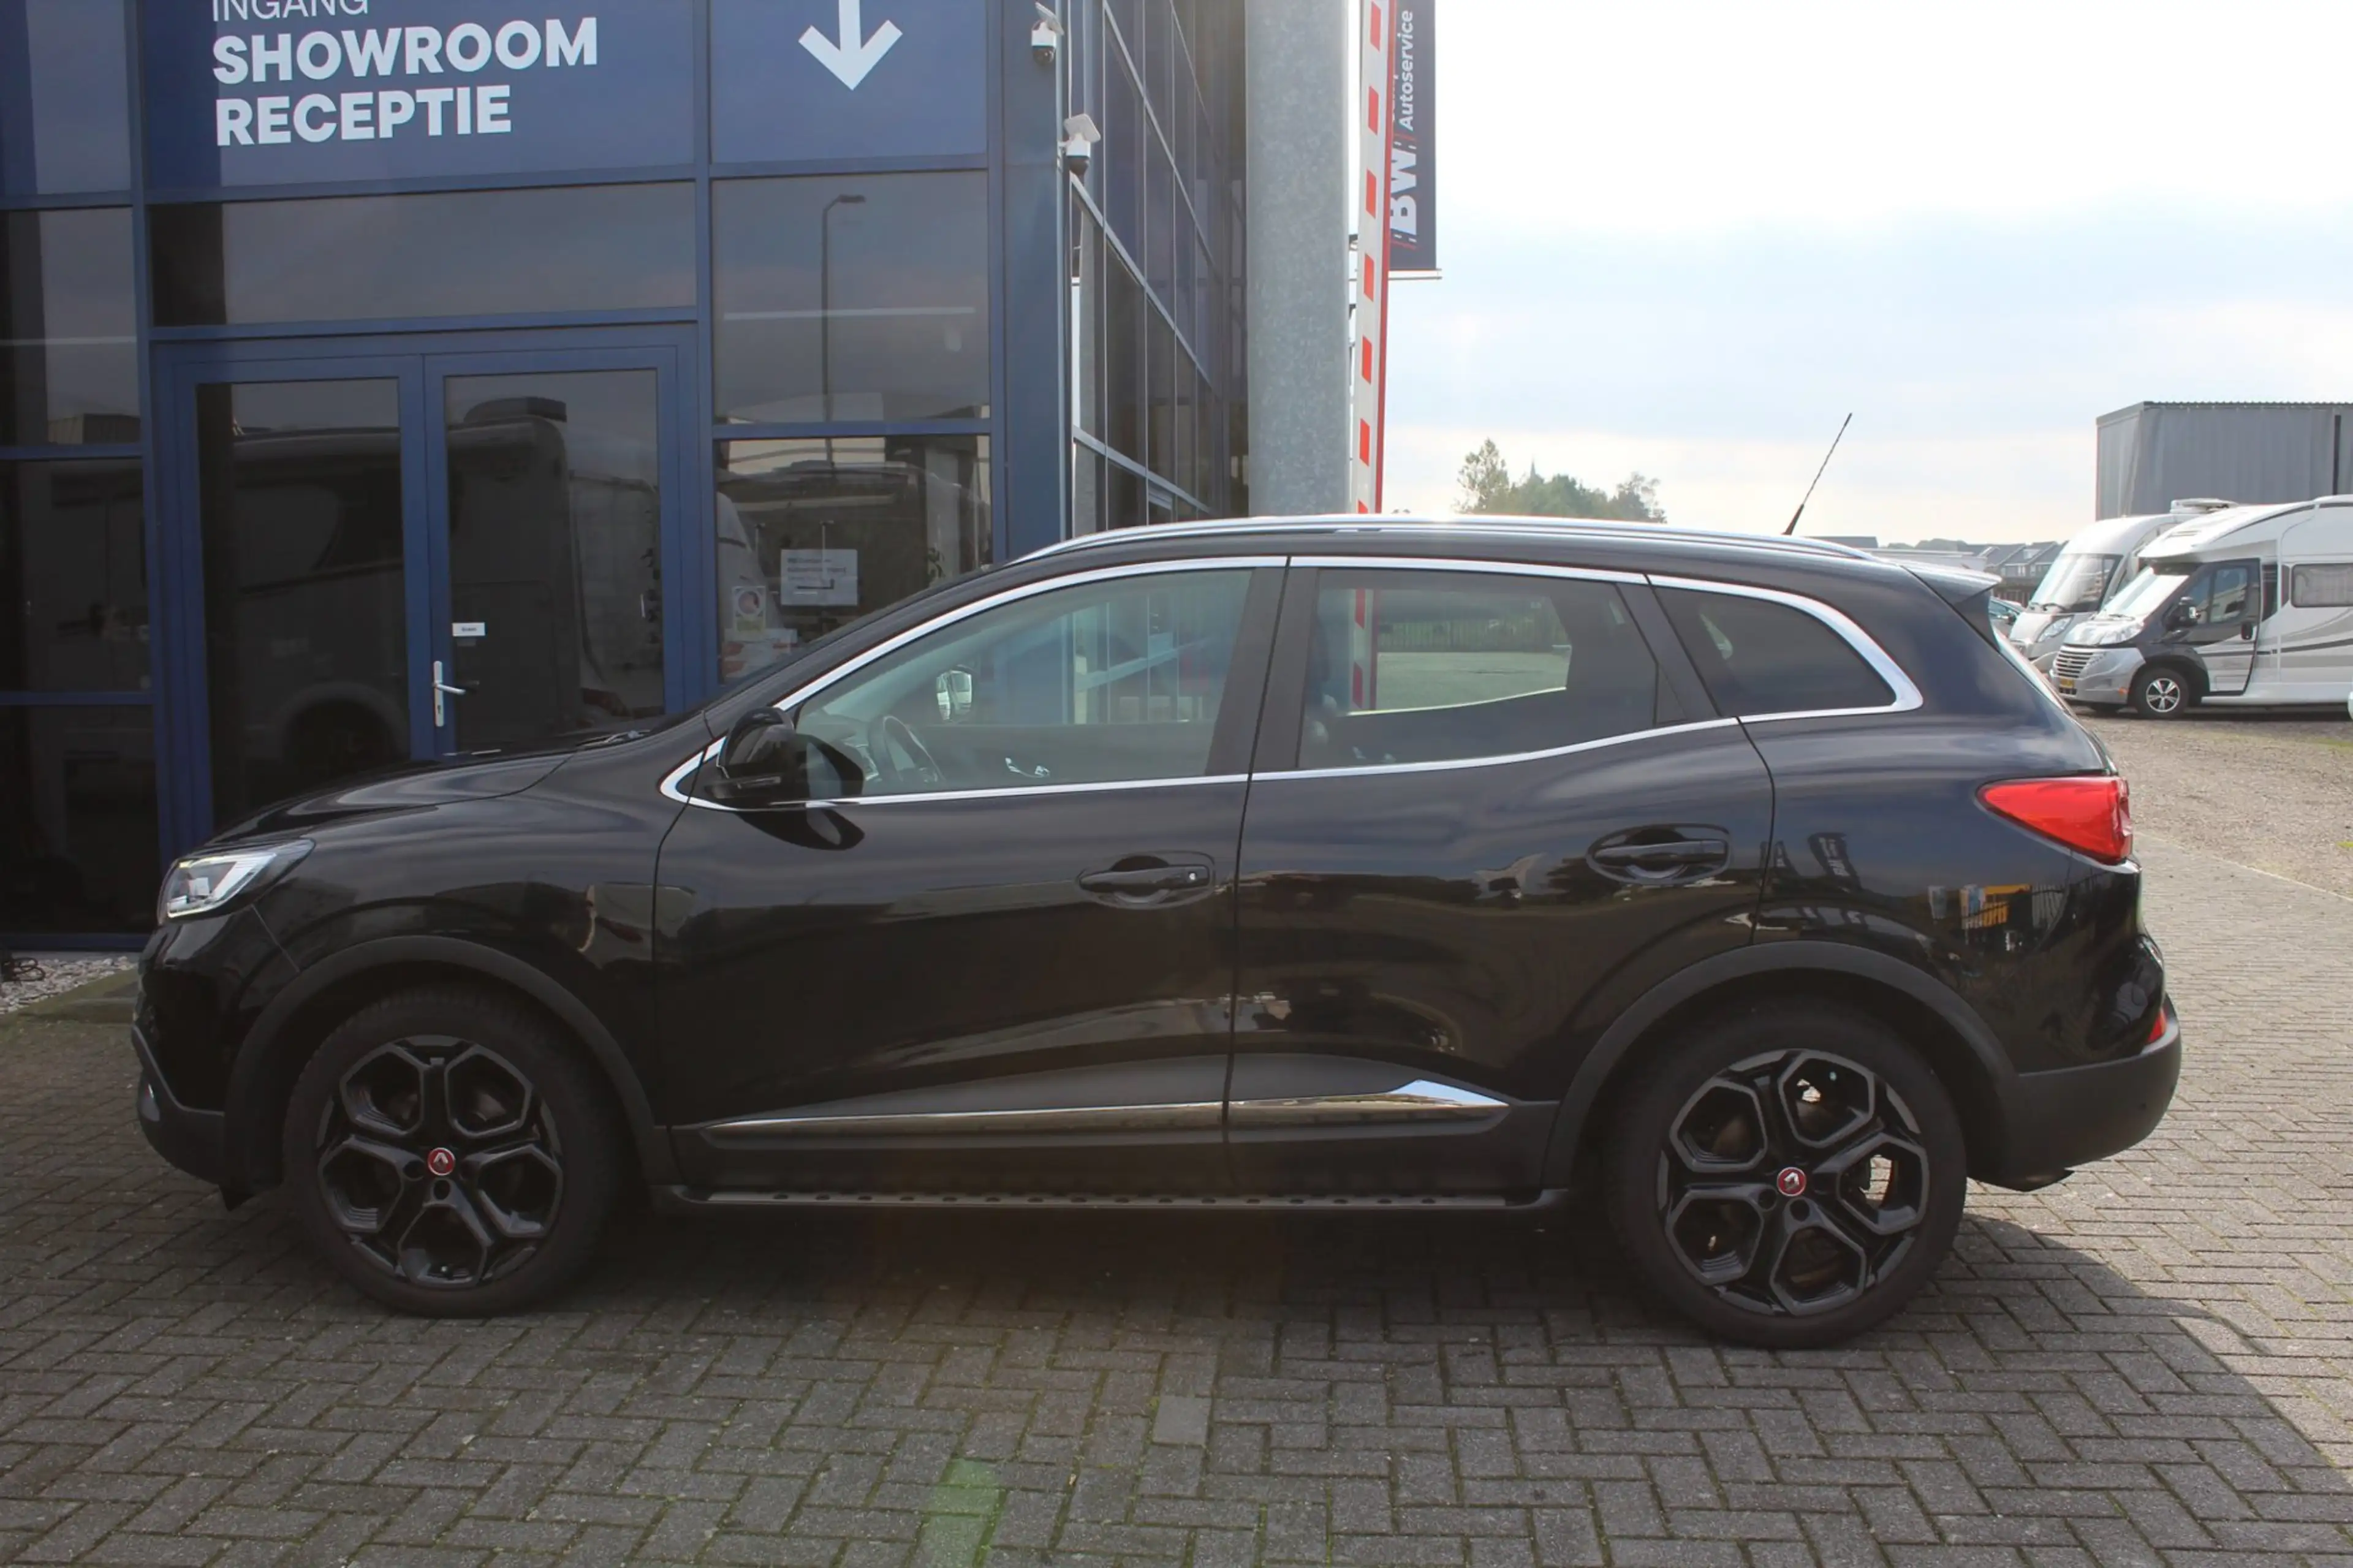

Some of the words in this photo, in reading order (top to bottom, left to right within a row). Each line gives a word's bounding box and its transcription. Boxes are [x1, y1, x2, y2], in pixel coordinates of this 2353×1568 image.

[213, 0, 368, 21] INGANG
[213, 17, 598, 84] SHOWROOM
[1398, 10, 1414, 131] Autoservice
[216, 85, 512, 146] RECEPTIE
